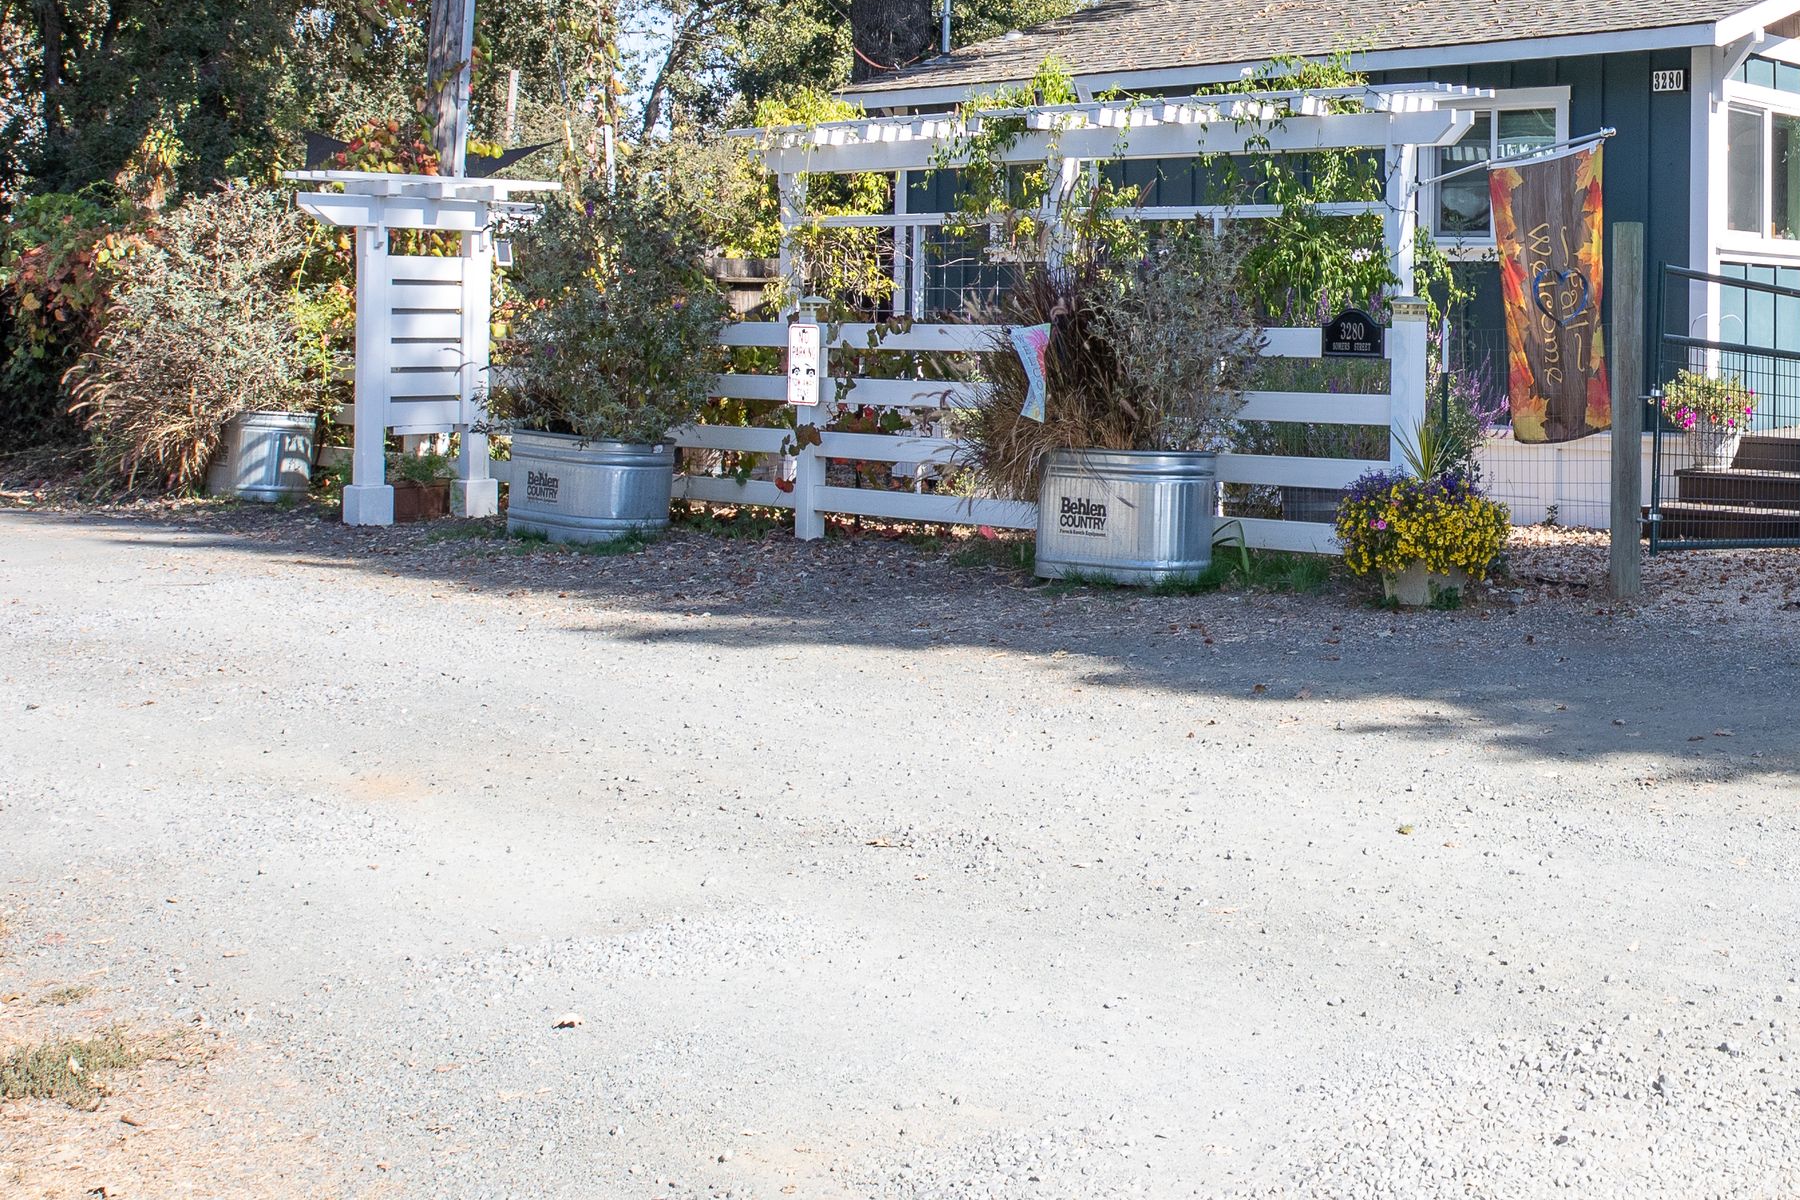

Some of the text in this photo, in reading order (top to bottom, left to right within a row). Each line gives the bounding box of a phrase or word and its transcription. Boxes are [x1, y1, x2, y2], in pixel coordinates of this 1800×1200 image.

[1654, 71, 1682, 90] 3280
[1527, 222, 1563, 386] Welcome
[1560, 266, 1590, 331] Fall
[1340, 321, 1365, 341] 3280
[1353, 342, 1372, 352] STREET
[527, 470, 559, 488] Behlen
[527, 485, 558, 499] COUNTRY
[1060, 496, 1107, 517] Behlen
[1060, 514, 1107, 531] COUNTRY
